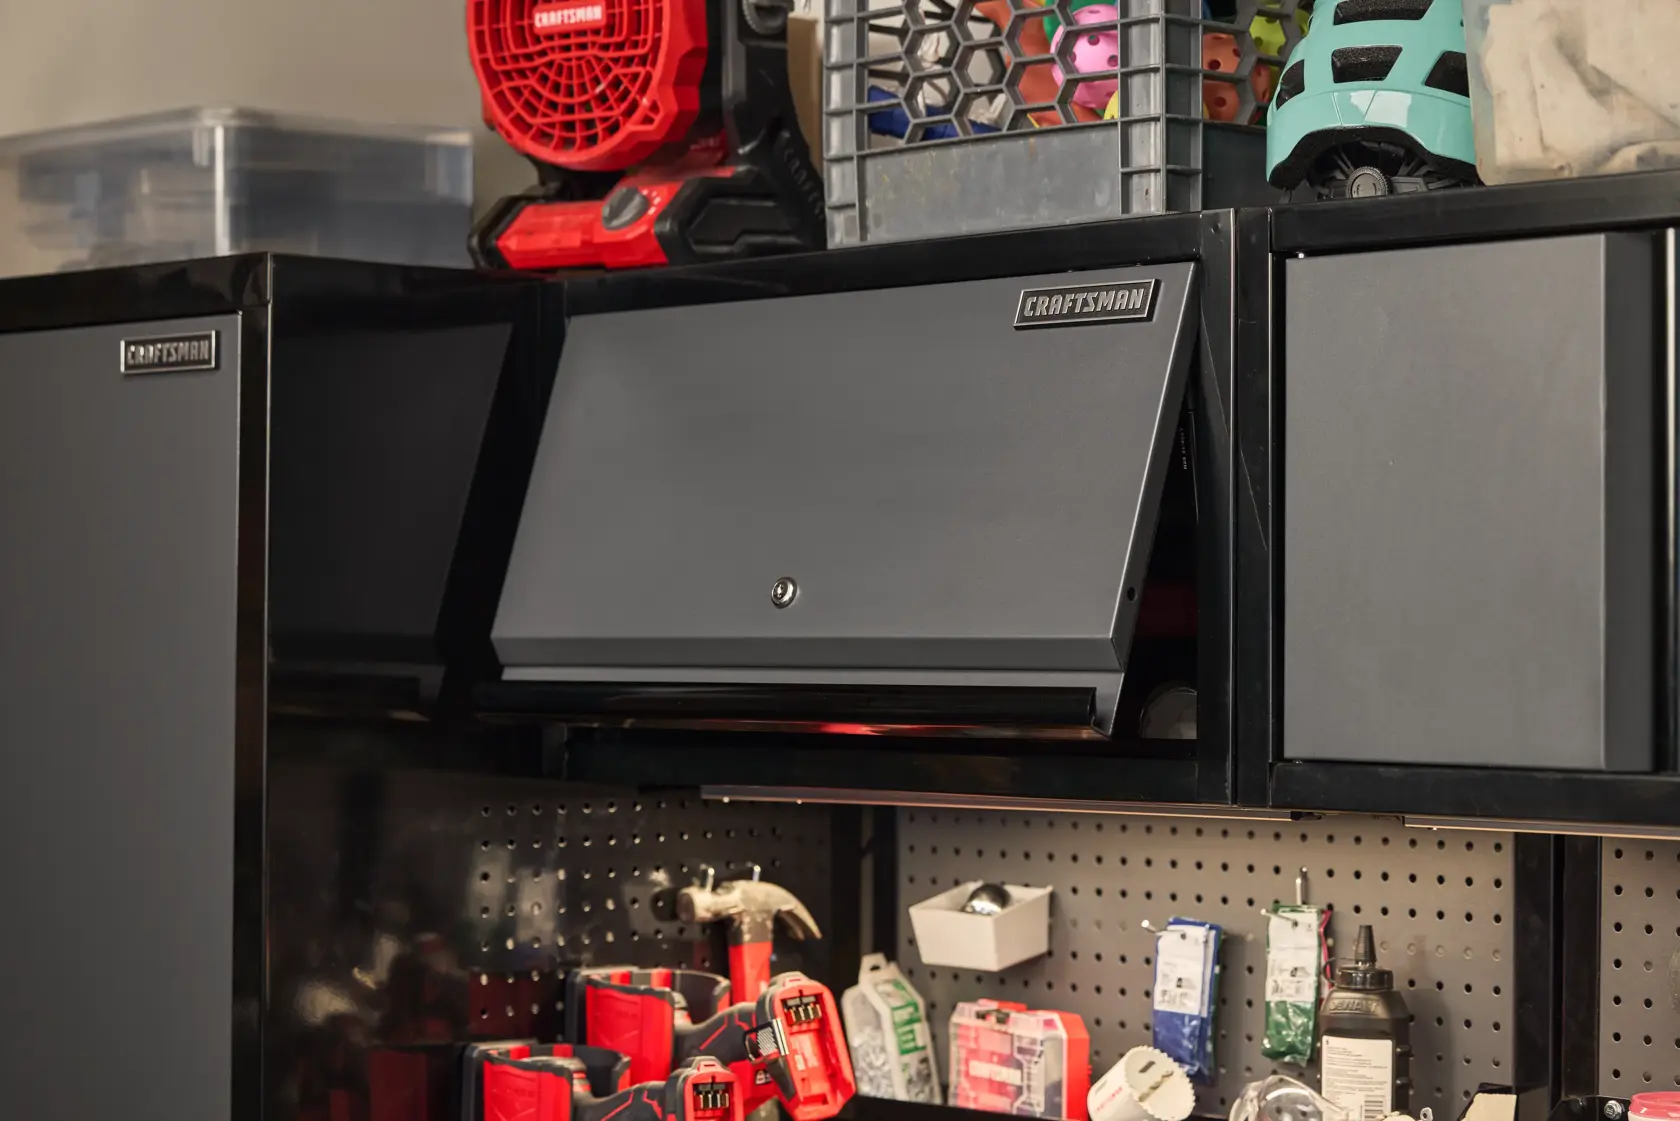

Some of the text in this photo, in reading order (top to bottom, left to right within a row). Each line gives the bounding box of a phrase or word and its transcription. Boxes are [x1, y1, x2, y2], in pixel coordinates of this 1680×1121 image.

[534, 5, 602, 28] CRAFTSMAN
[1024, 289, 1144, 316] CRAFTSMAN
[127, 340, 209, 364] CRAFTSMAN
